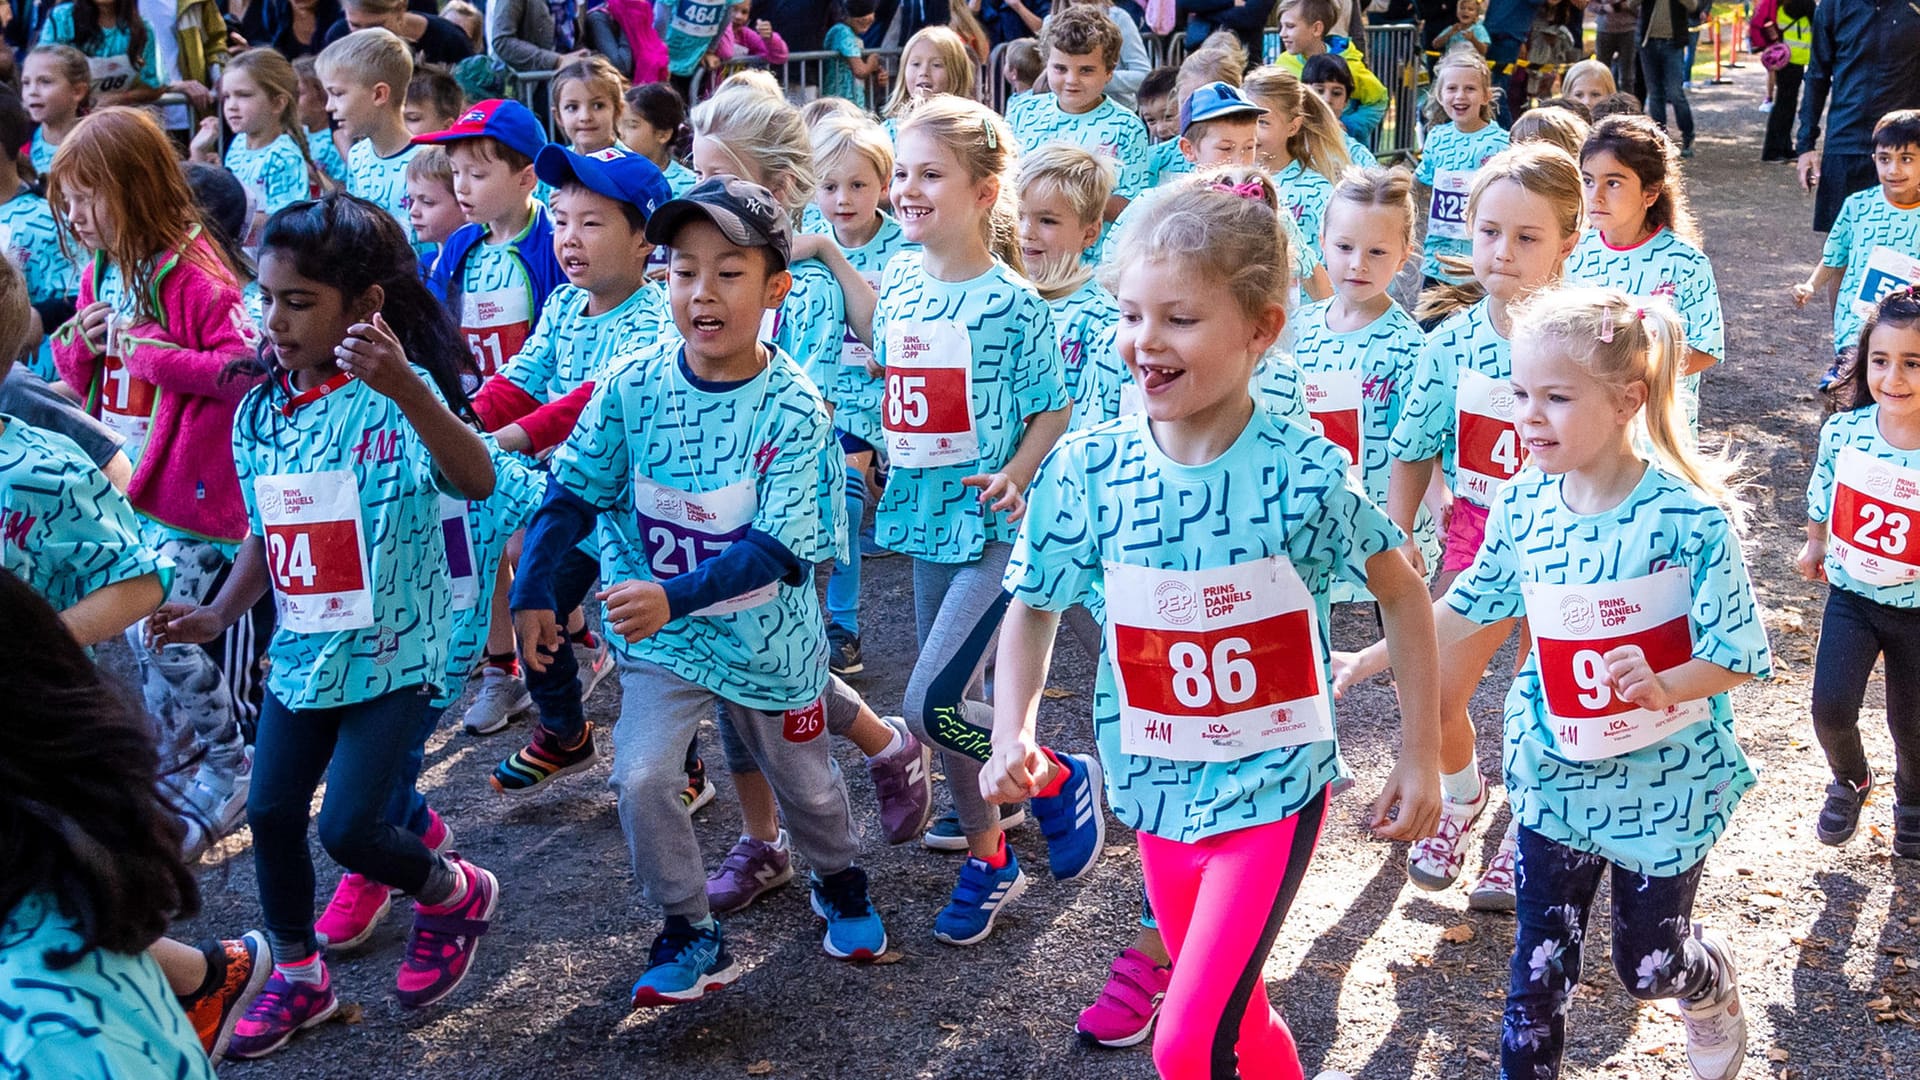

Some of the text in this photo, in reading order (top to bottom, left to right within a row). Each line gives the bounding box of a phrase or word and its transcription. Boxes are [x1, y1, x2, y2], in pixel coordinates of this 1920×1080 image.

[685, 4, 717, 23] 464
[1860, 223, 1918, 247] PEP!
[468, 332, 504, 376] 51
[888, 374, 929, 427] 85
[351, 429, 398, 465] H&M
[1469, 477, 1489, 496] H&M
[1896, 477, 1917, 489] PRINS
[1896, 483, 1920, 496] DANIEL
[283, 497, 314, 505] DANIELS
[1095, 469, 1232, 552] PEP!
[886, 519, 963, 556] PEP!
[1853, 503, 1912, 556] 23
[269, 533, 318, 588] 24
[1203, 583, 1236, 598] PRINS
[1204, 591, 1252, 609] DANIELS
[1156, 592, 1198, 615] PEP!
[1206, 604, 1234, 619] LOPP
[1561, 602, 1595, 623] PEP!
[1599, 597, 1627, 609] PRINS
[1600, 604, 1642, 618] DANIELS
[1602, 616, 1628, 628] LOPP
[1168, 637, 1258, 709] 86
[1572, 644, 1646, 711] 9
[793, 711, 819, 735] 26
[1144, 719, 1173, 745] H&M
[1208, 724, 1229, 734] ICA
[1609, 719, 1628, 731] ICA
[1559, 724, 1579, 747] H&M
[1530, 757, 1629, 791] PEP!
[1585, 786, 1694, 840] PEP!
